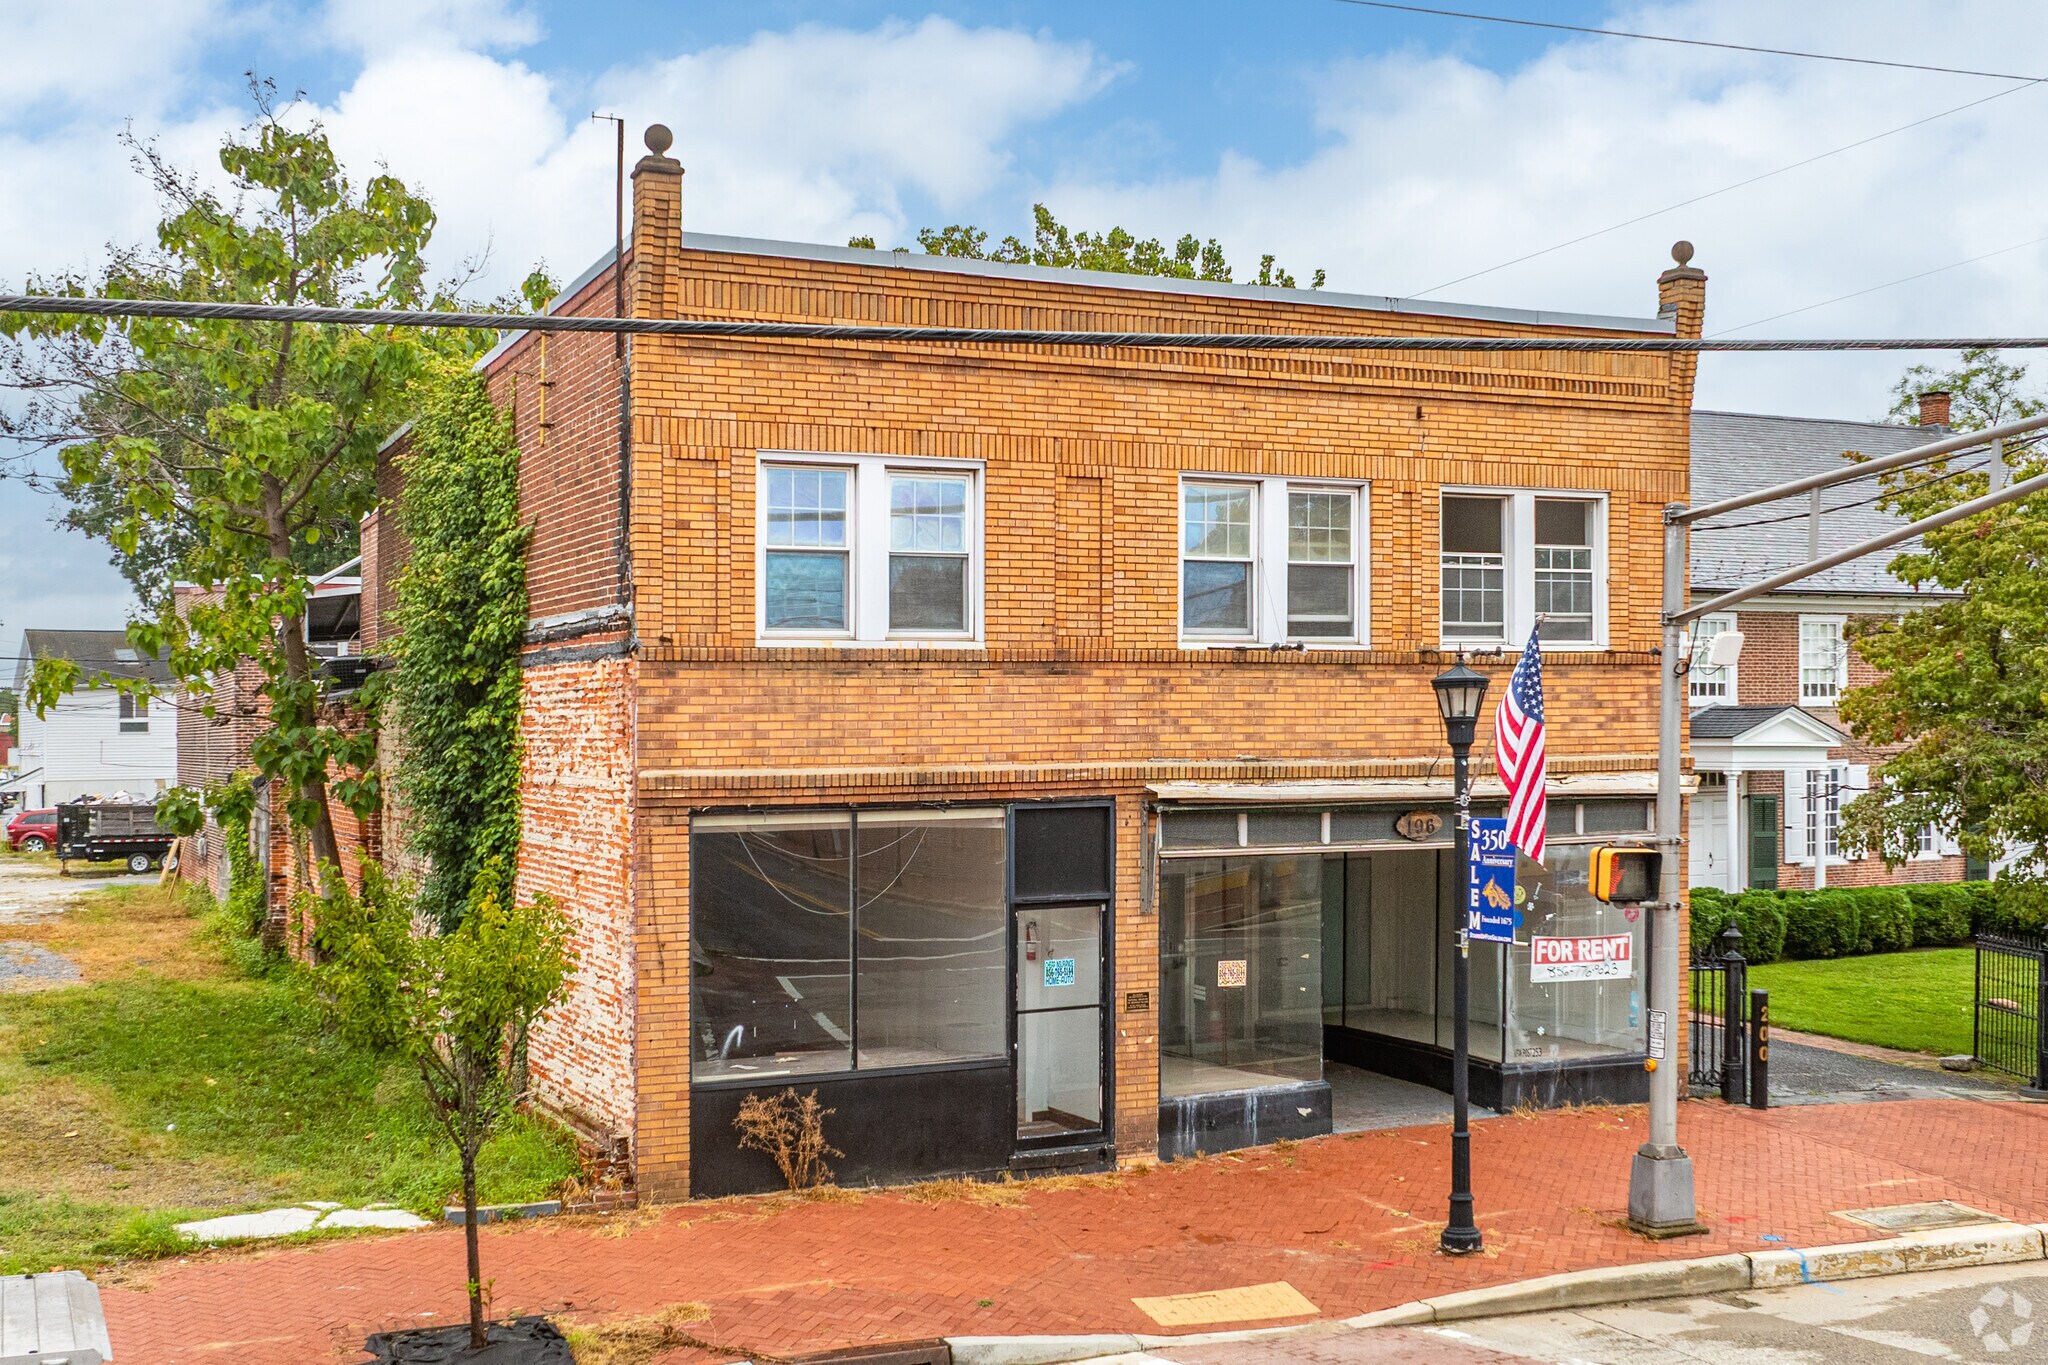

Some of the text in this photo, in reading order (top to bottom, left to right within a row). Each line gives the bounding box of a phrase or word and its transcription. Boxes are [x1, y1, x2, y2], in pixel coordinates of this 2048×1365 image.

[1407, 818, 1435, 836] 196
[1482, 855, 1514, 867] Anniversary
[1469, 819, 1481, 930] SALEM
[1481, 914, 1500, 924] Founded
[1536, 937, 1628, 962] FOR RENT
[1759, 1006, 1768, 1061] 200
